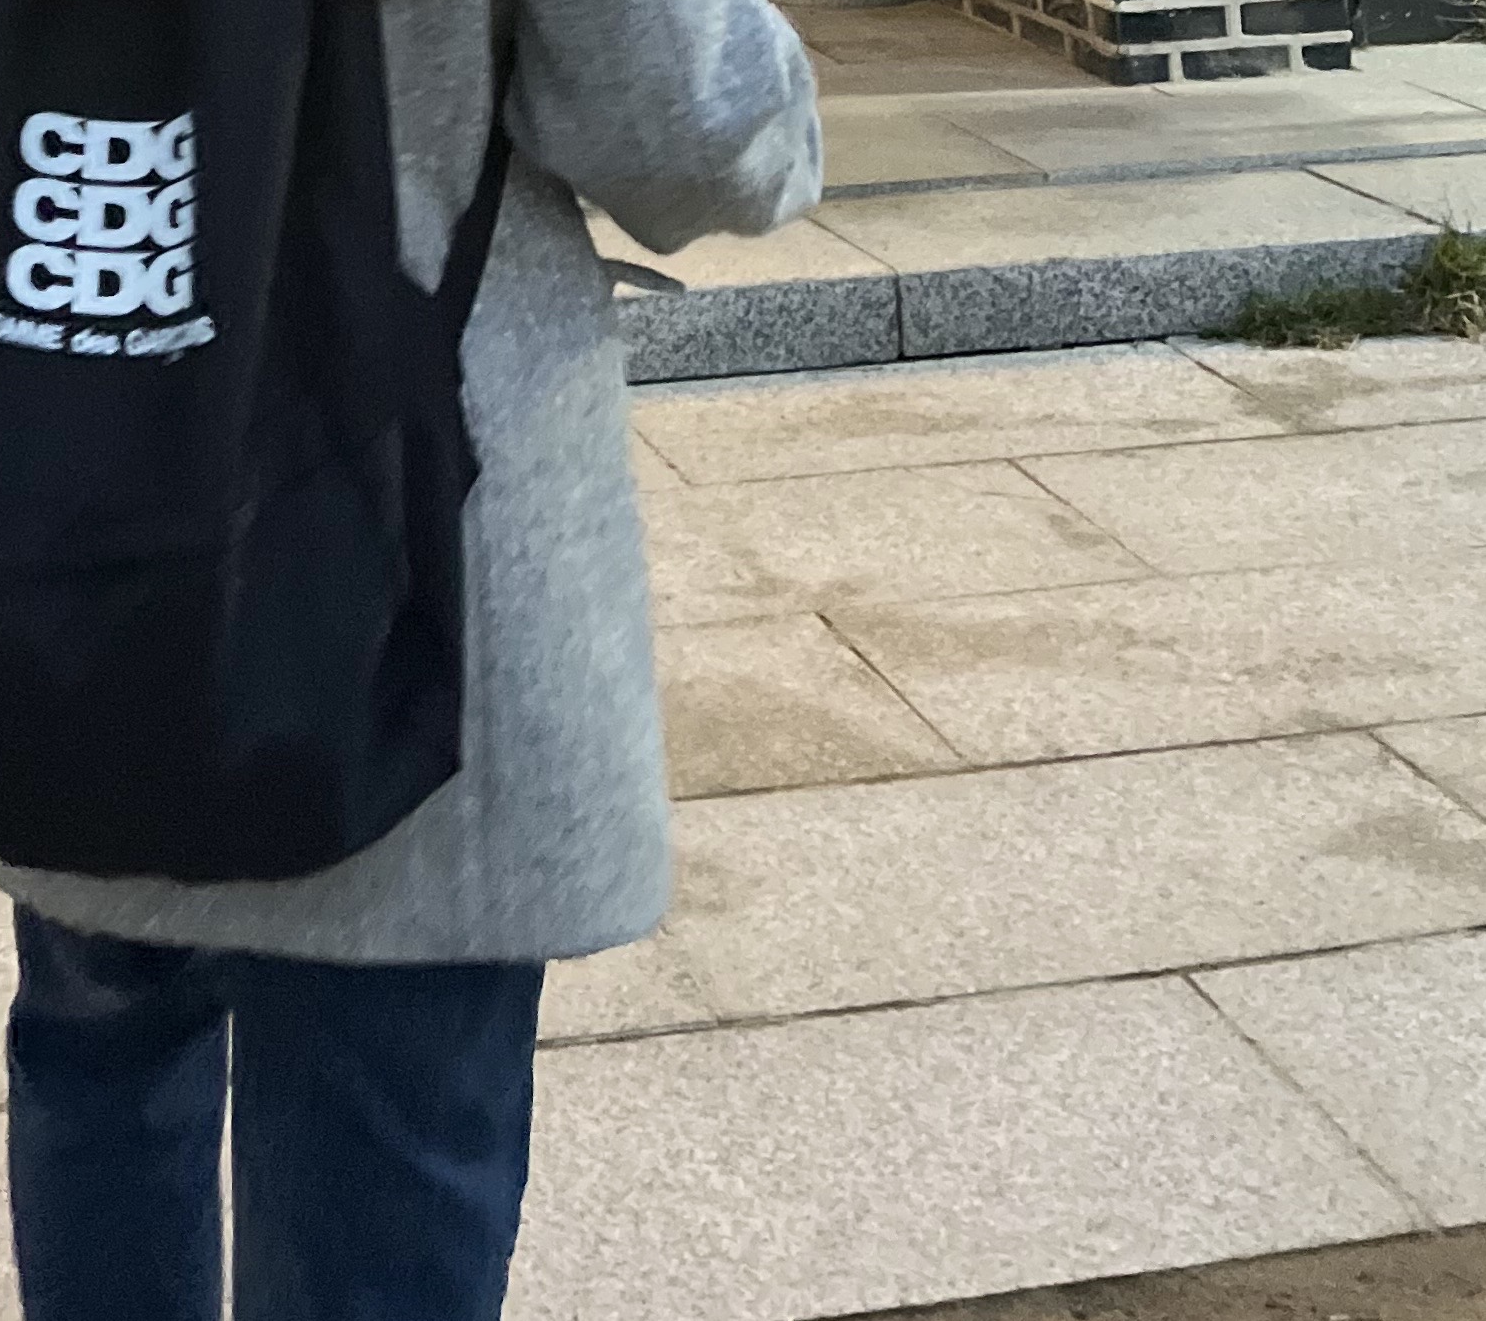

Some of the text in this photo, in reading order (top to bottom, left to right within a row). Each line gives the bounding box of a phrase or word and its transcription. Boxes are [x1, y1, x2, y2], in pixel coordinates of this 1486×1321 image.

[19, 110, 196, 181] CDG
[14, 176, 196, 247] CDG
[5, 243, 195, 316] CDG
